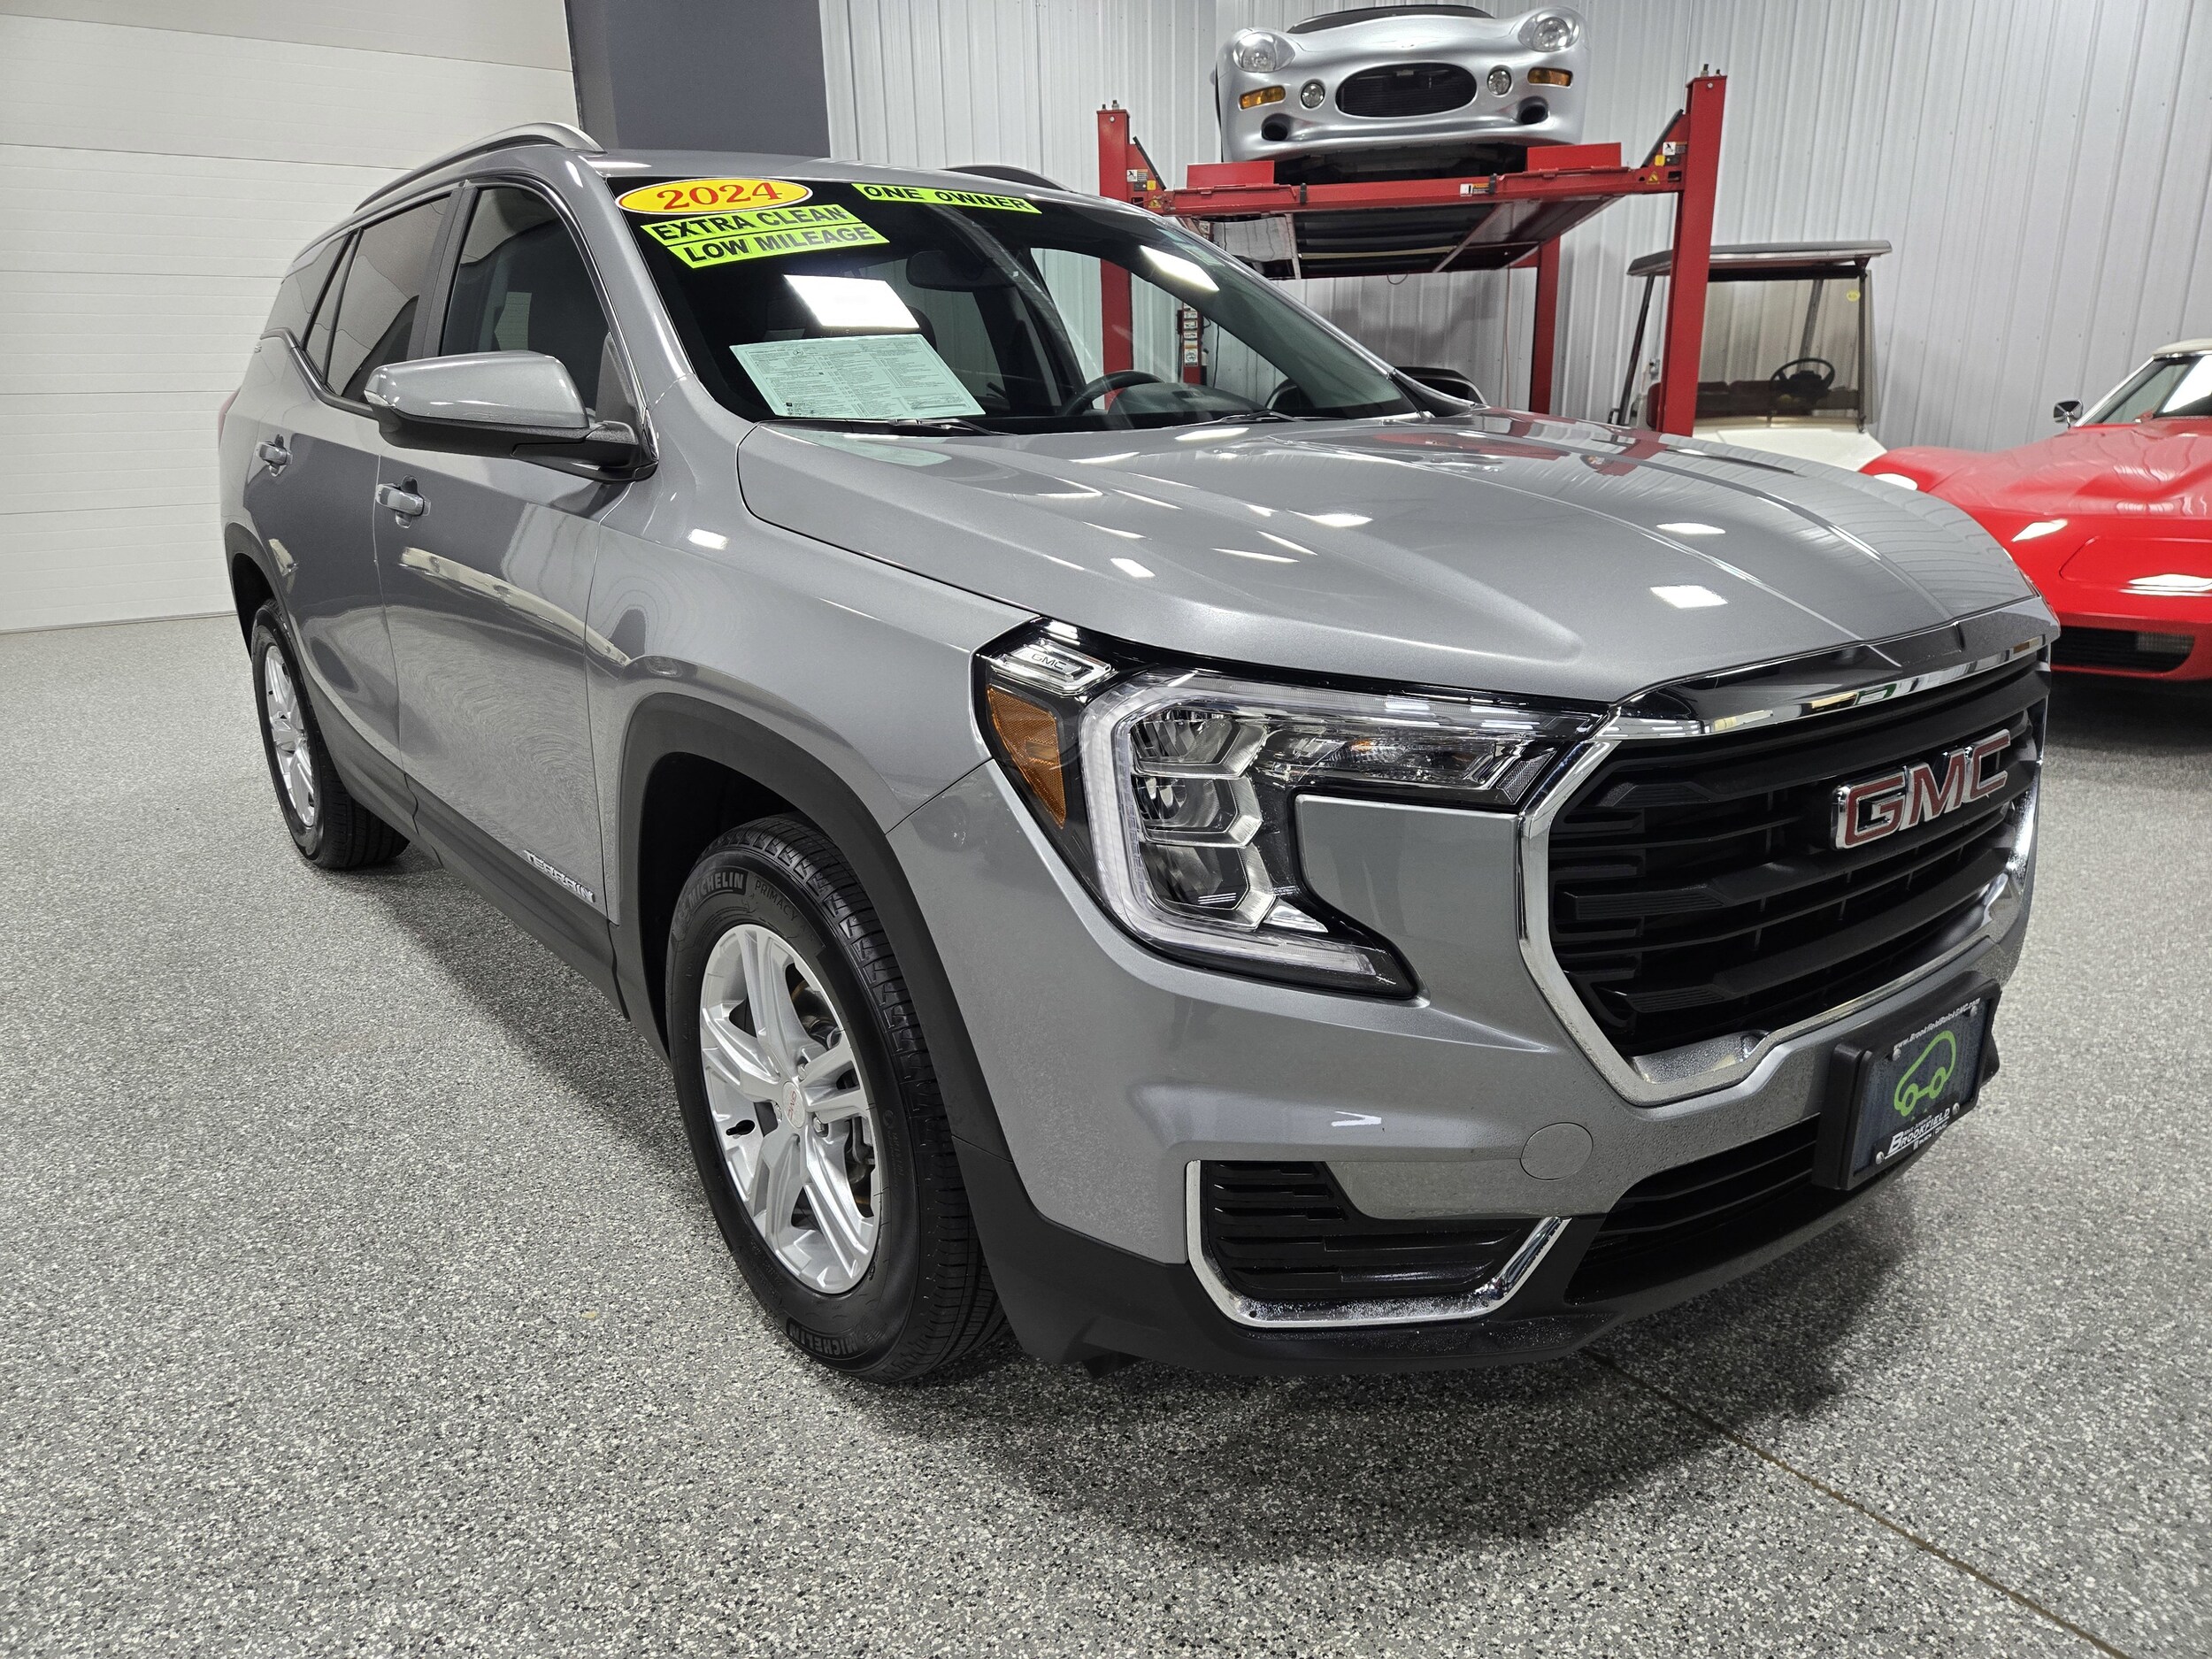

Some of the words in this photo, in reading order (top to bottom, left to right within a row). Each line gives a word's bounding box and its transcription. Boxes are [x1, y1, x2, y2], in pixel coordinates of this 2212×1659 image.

[657, 182, 782, 210] 2024
[864, 186, 925, 200] ONE
[934, 191, 1033, 211] OWNER
[651, 215, 758, 241] EXTRA
[757, 207, 849, 226] CLEAN
[683, 239, 751, 262] LOW
[754, 227, 876, 251] MILEAGE
[1031, 652, 1068, 671] GMC
[1833, 728, 2011, 849] GMC
[524, 849, 595, 902] TERRAIN
[688, 872, 744, 910] MICHELIN
[755, 879, 797, 921] PRIMACY
[1887, 1107, 1951, 1156] BROOKFIELD
[789, 1323, 859, 1356] MICHELIN
